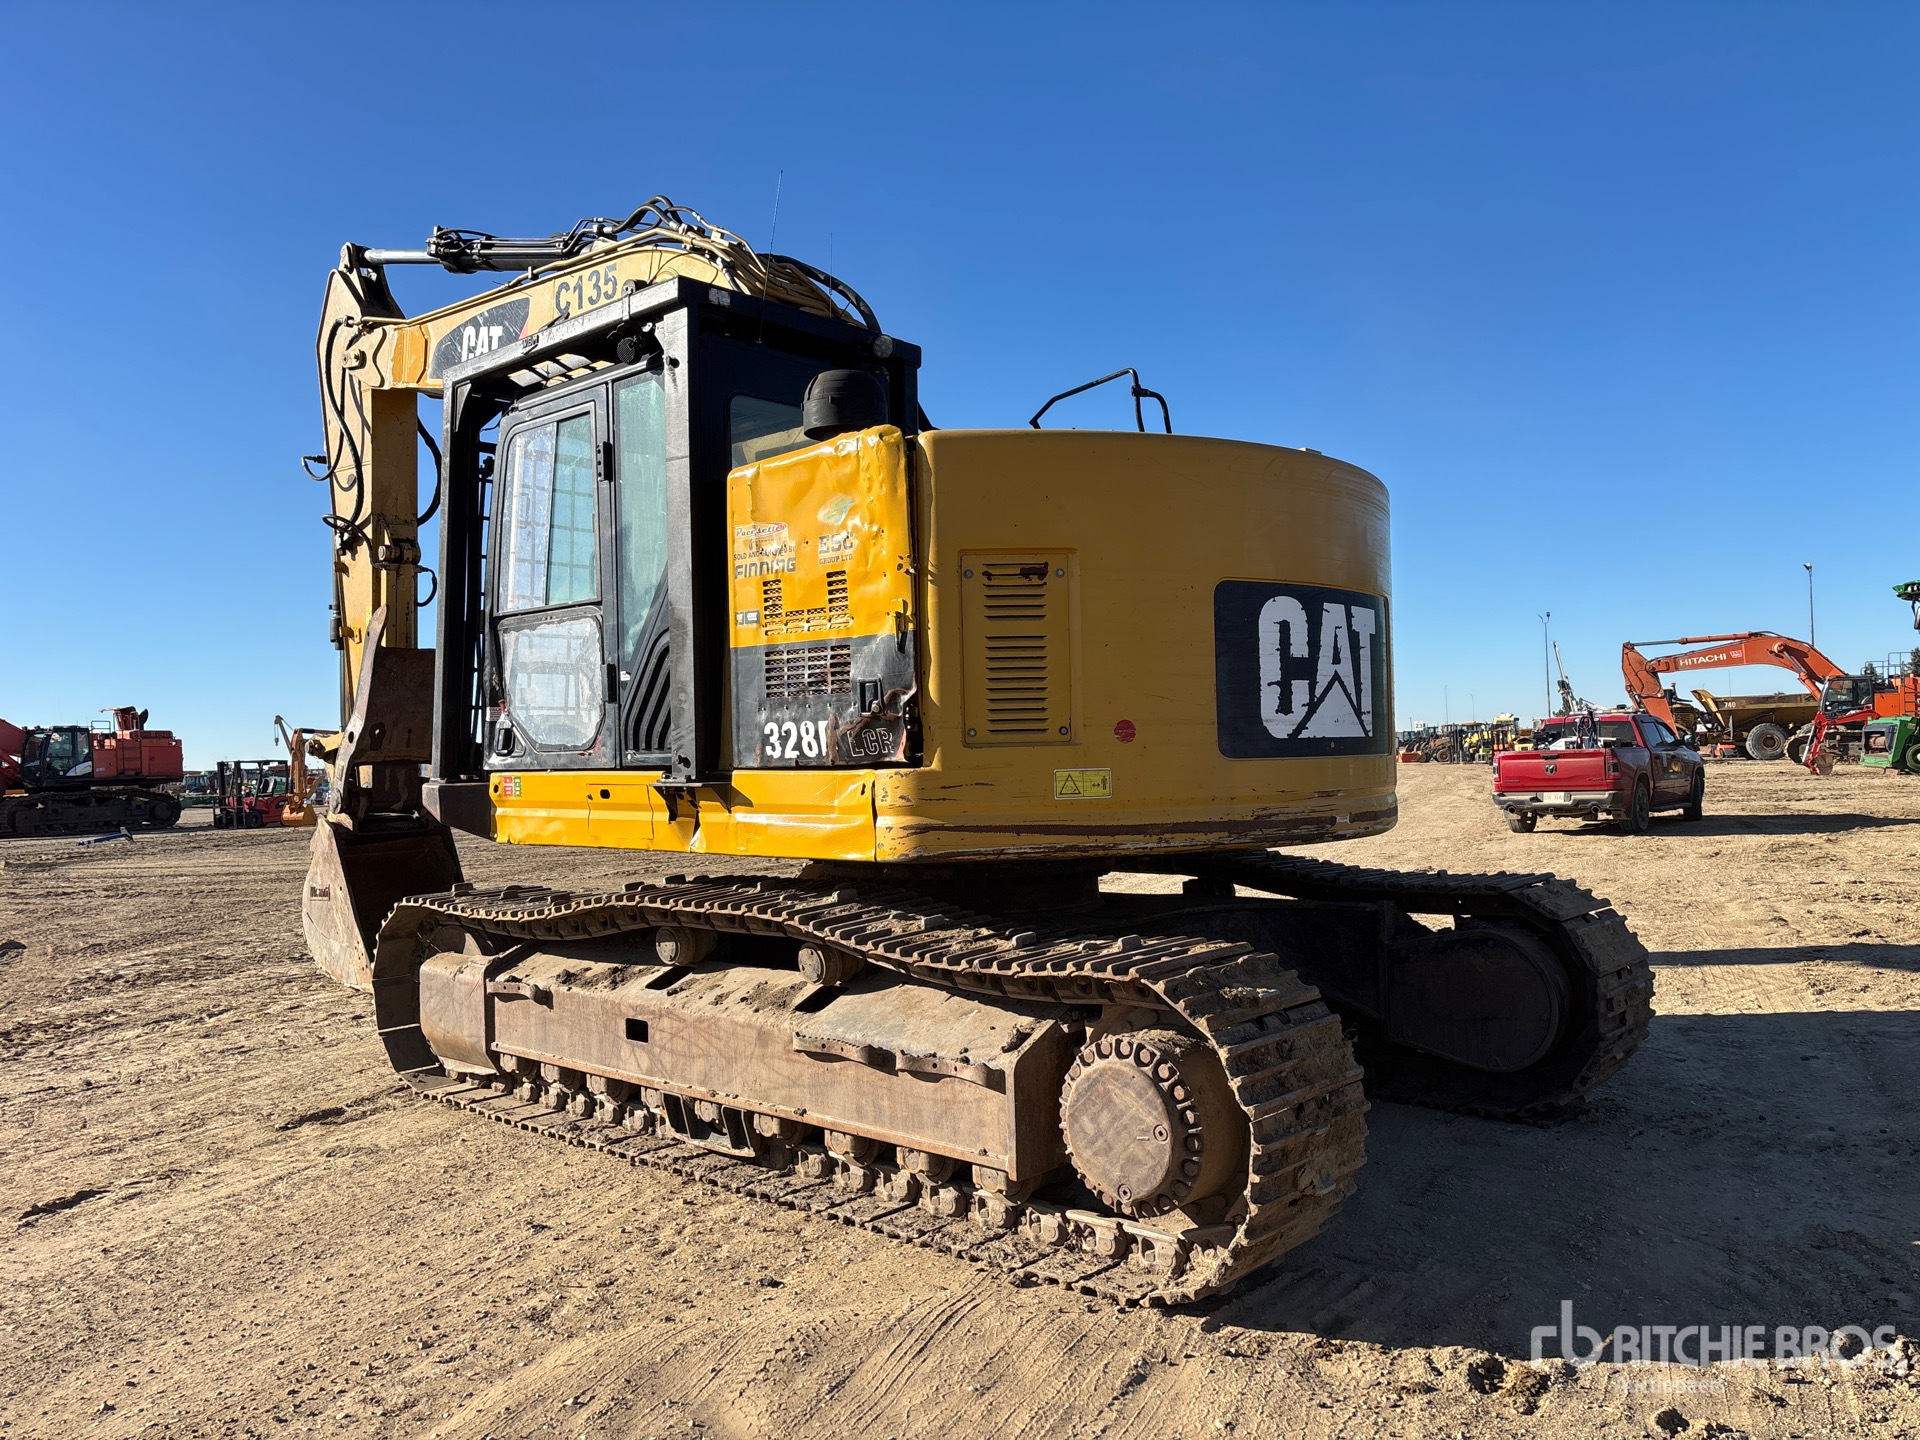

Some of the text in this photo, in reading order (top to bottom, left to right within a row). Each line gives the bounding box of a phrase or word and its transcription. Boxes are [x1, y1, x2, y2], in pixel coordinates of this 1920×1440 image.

[556, 262, 618, 315] C135
[461, 325, 503, 363] CAT
[734, 552, 748, 560] SOLD
[819, 555, 840, 564] GROUP
[1258, 595, 1376, 739] CAT
[1679, 652, 1727, 667] HITACHI
